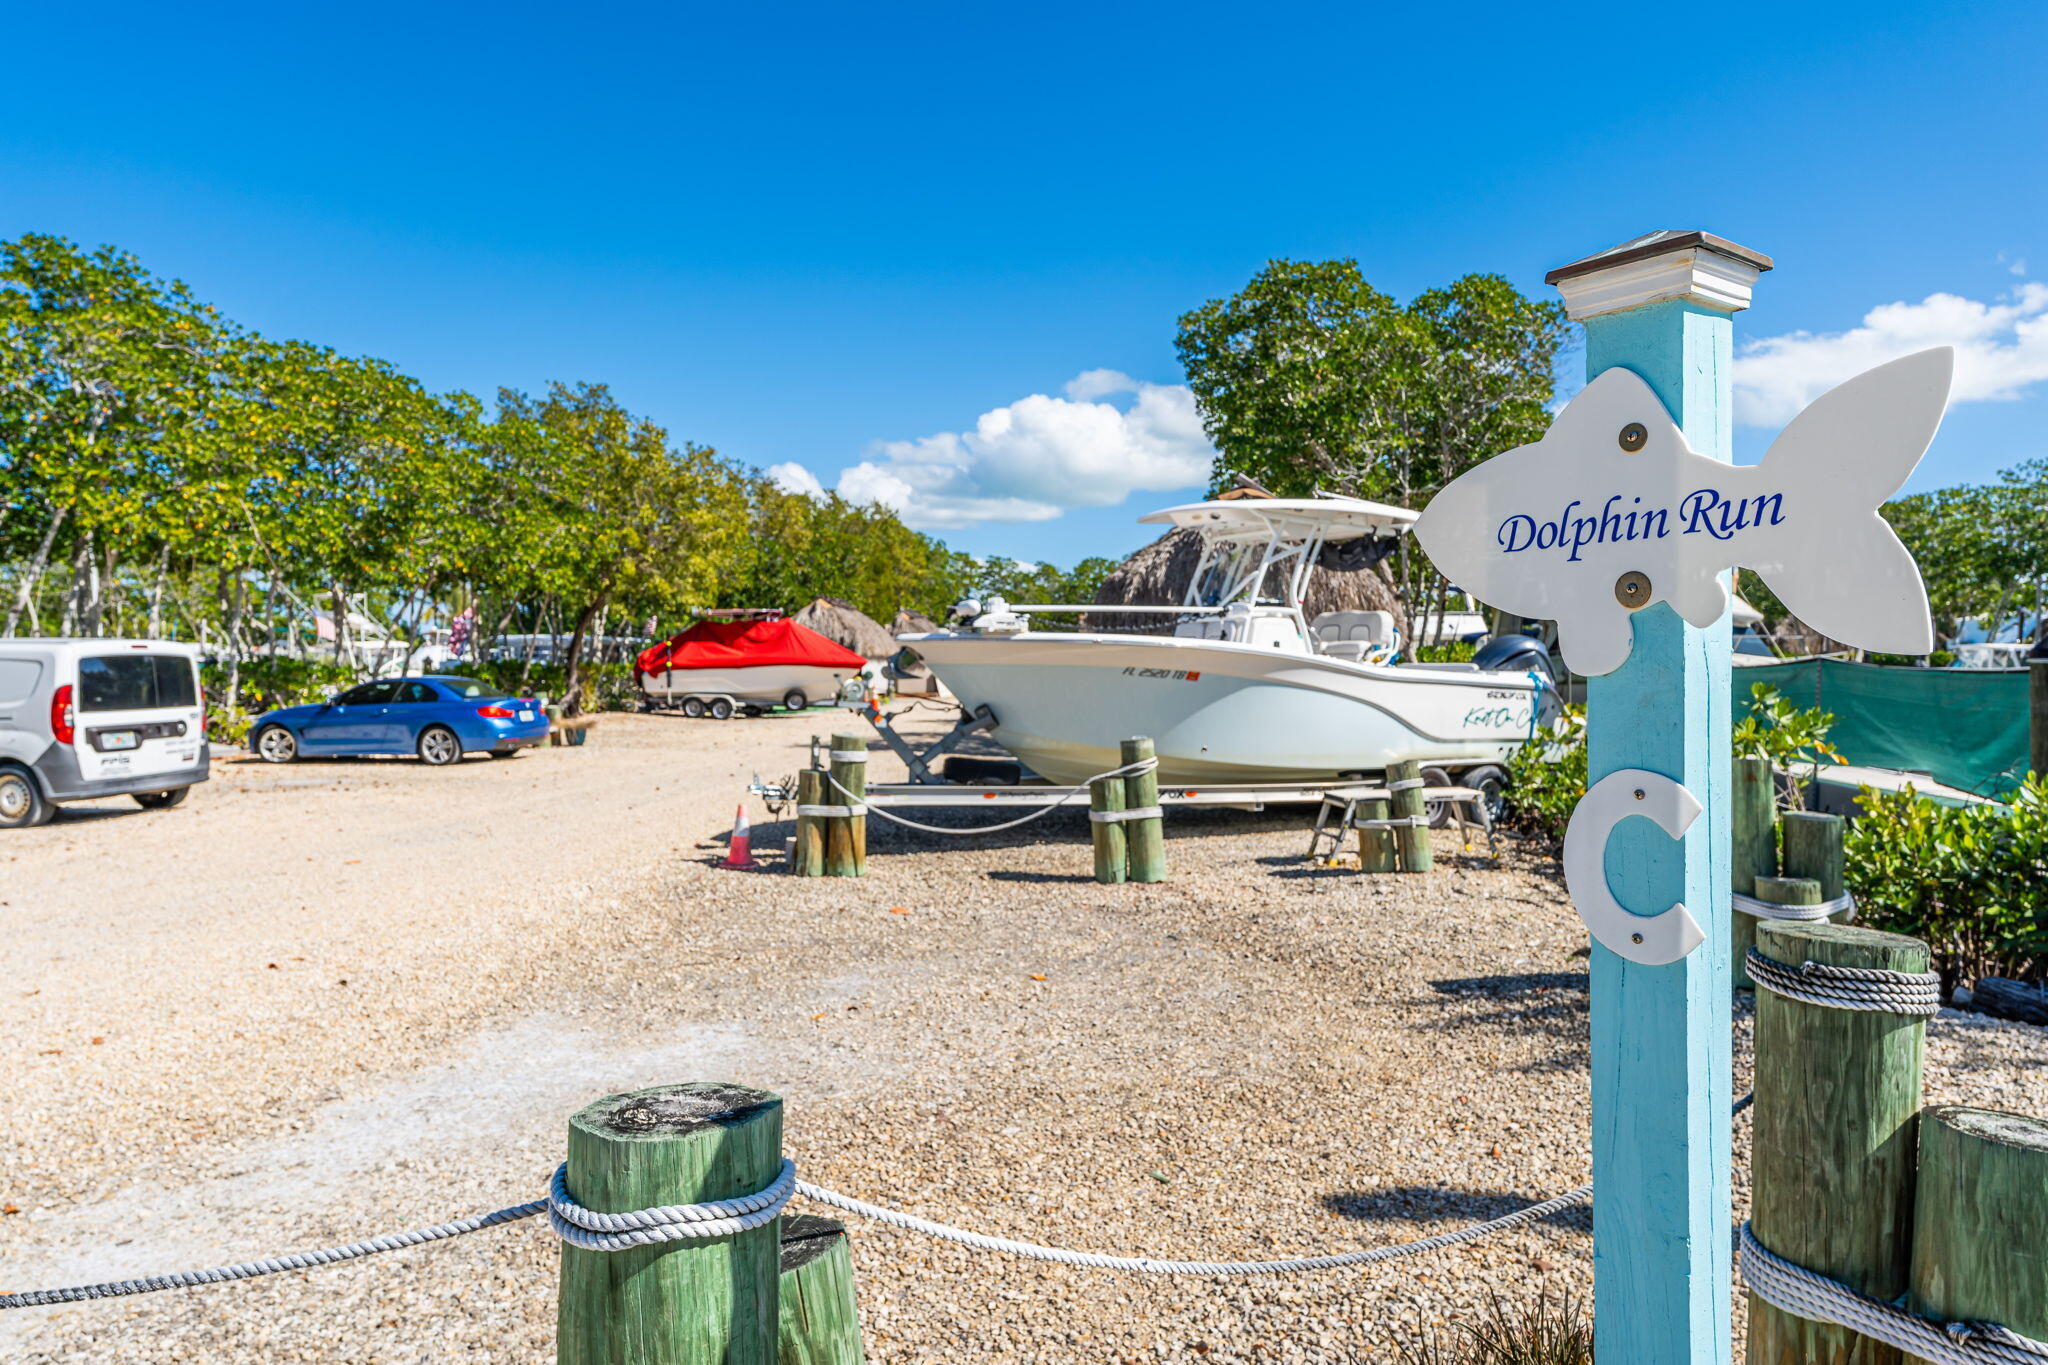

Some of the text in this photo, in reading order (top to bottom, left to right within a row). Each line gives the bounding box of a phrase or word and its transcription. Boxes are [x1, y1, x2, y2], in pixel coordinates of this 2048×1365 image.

[1497, 488, 1786, 562] Dolphin Run
[1122, 666, 1136, 676] FL
[1563, 768, 1707, 966] C
